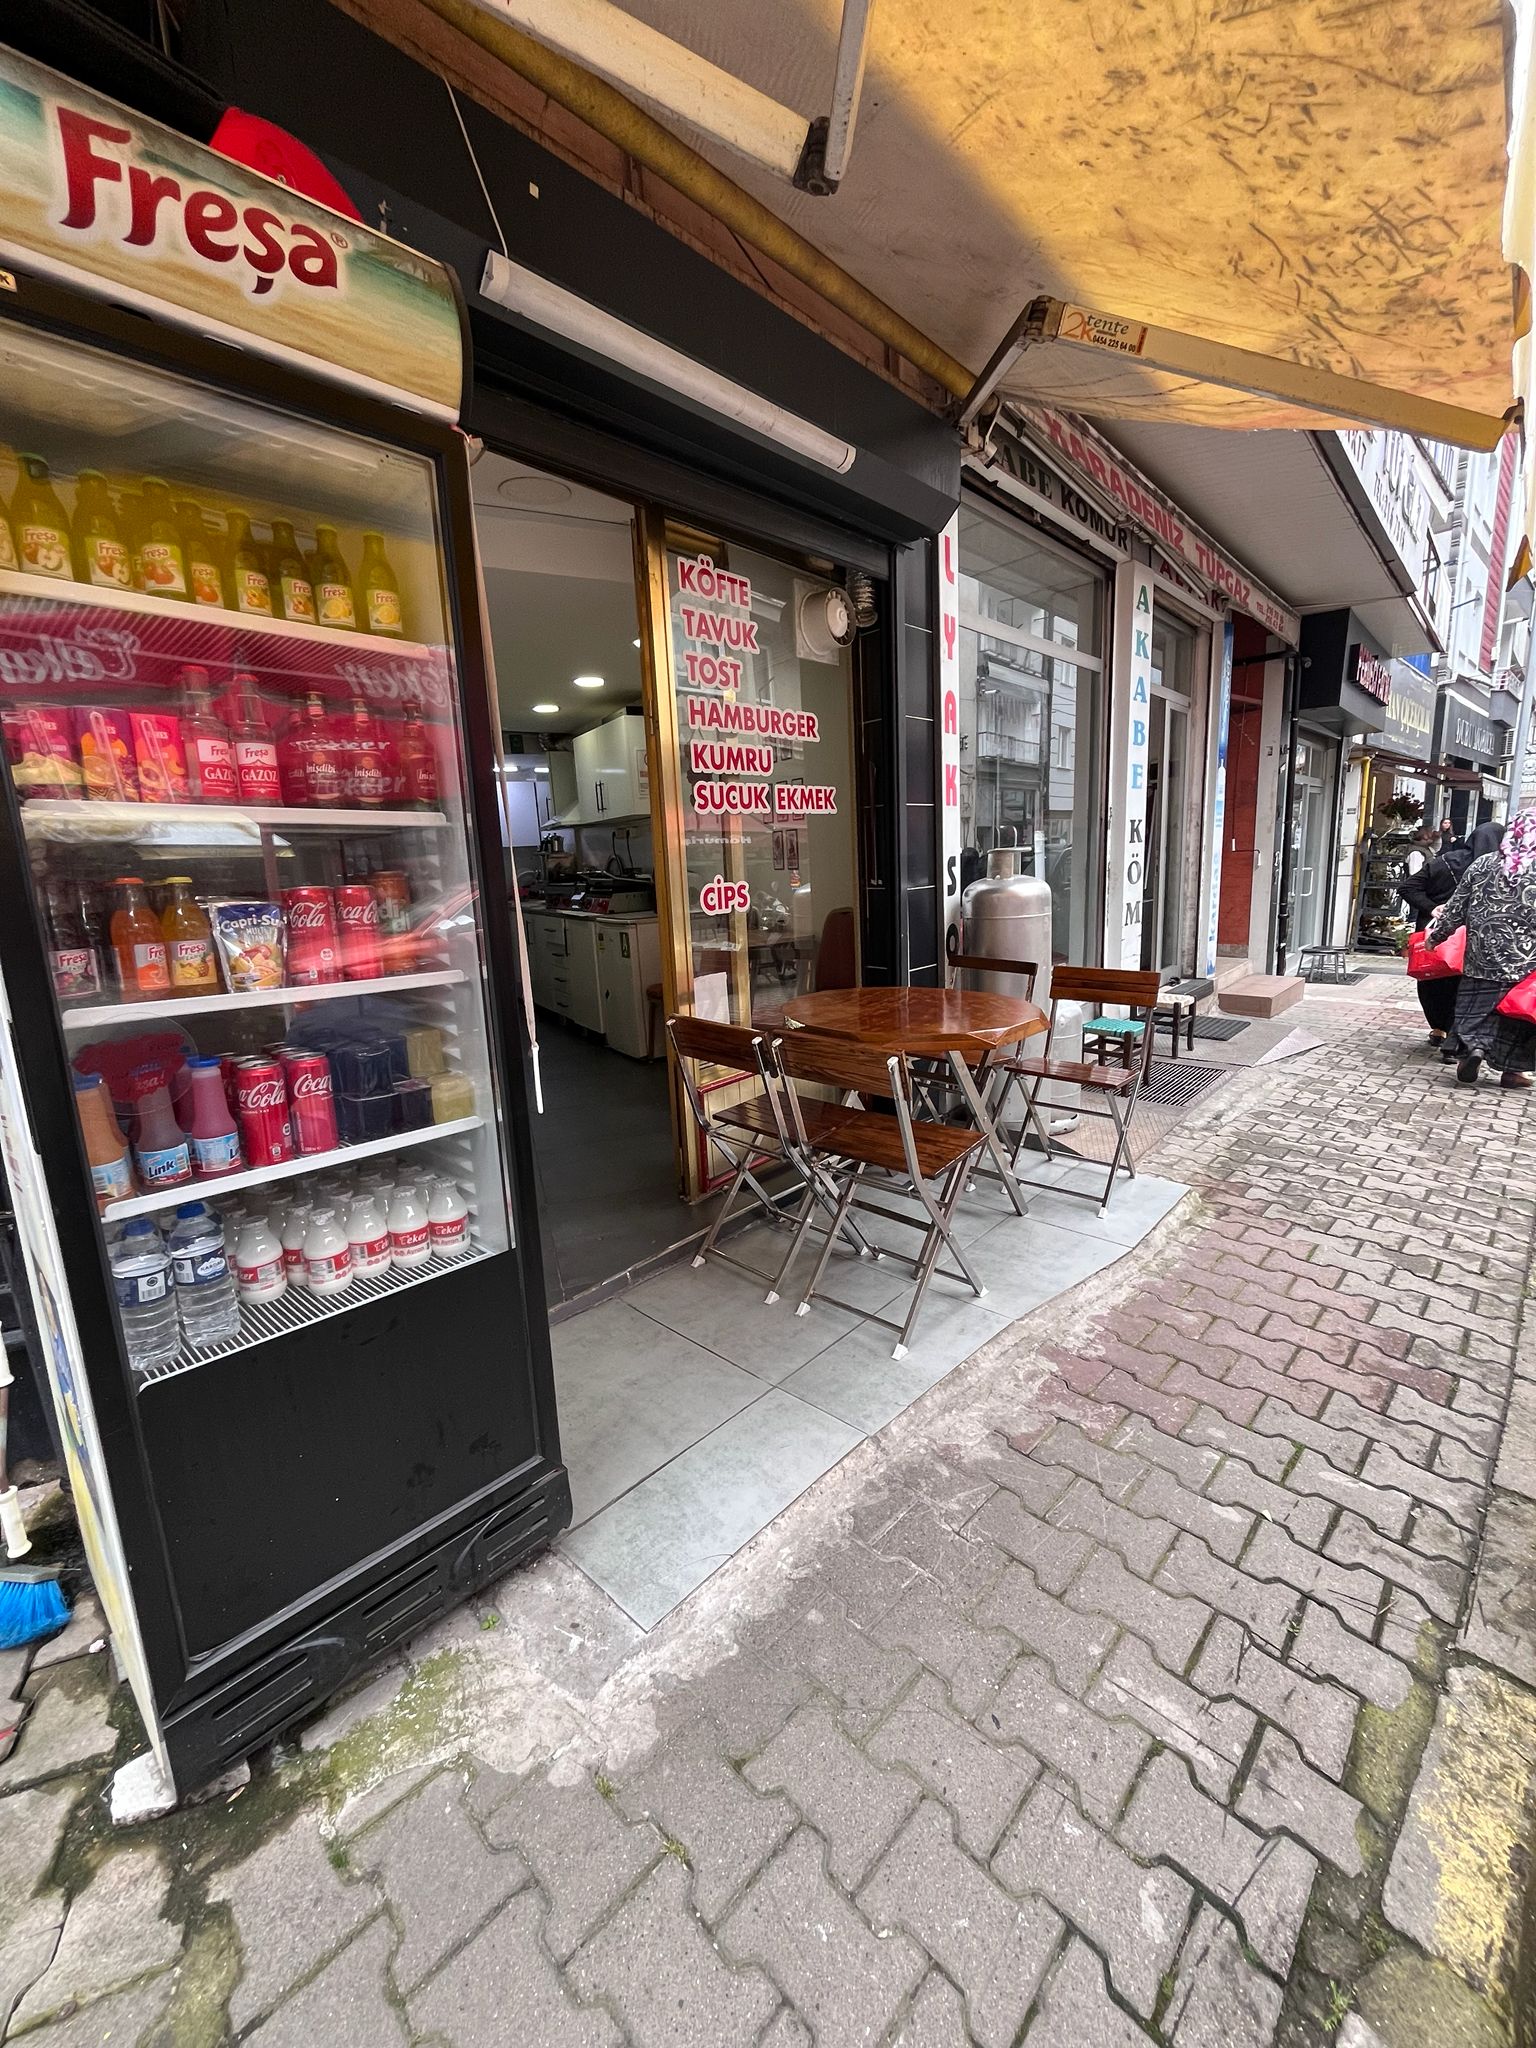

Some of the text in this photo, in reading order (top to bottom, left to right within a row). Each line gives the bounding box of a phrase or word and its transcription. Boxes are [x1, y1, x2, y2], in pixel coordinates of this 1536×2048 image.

[57, 105, 339, 295] Freşa
[1087, 315, 1130, 335] tente
[678, 557, 751, 608] KÖFTE
[1195, 542, 1250, 609] TÜPGAZ
[681, 608, 758, 650] TAVUK
[685, 653, 741, 689] TOST
[688, 698, 819, 740] HAMBURGER
[241, 768, 277, 783] GAZOZ
[692, 743, 772, 773] KUMRU
[696, 783, 837, 811] SUCUK EKMEK
